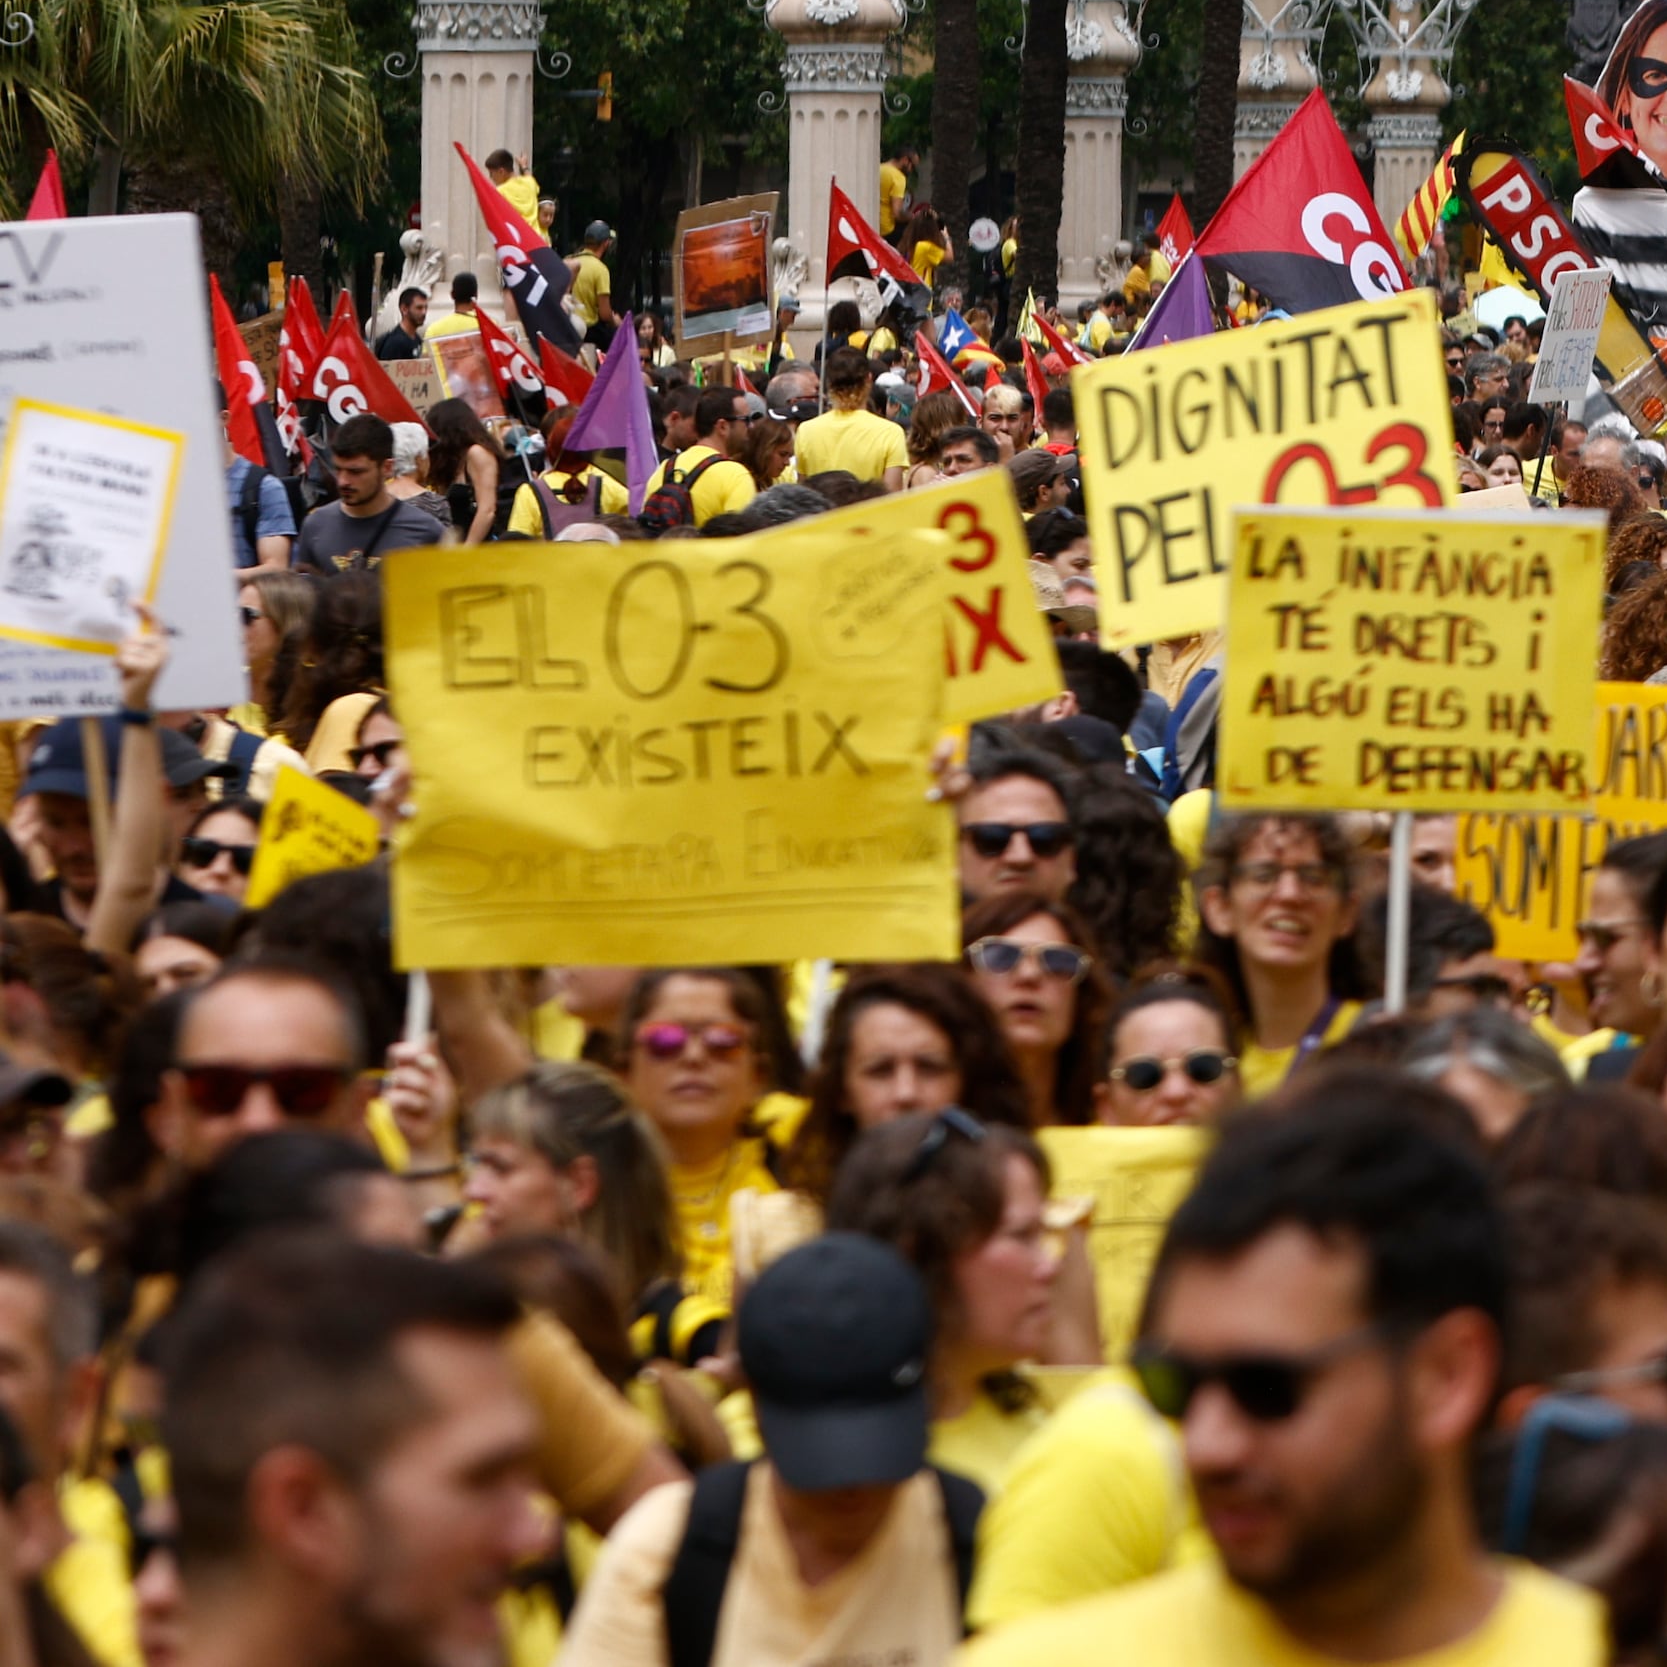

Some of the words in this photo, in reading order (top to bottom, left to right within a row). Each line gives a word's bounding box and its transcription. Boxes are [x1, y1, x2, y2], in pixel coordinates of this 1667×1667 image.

[1112, 485, 1229, 603] PEL
[1244, 534, 1306, 581] LA
[438, 583, 588, 692] EL
[1268, 588, 1333, 651] TÉ
[1354, 611, 1497, 667] DRETS
[1250, 663, 1371, 718] ALGÚ
[1386, 686, 1467, 732] ELS
[1487, 690, 1552, 739] HA
[1266, 746, 1323, 785] DE
[1358, 741, 1591, 802] DEFENSAR
[1463, 813, 1562, 931] SOM
